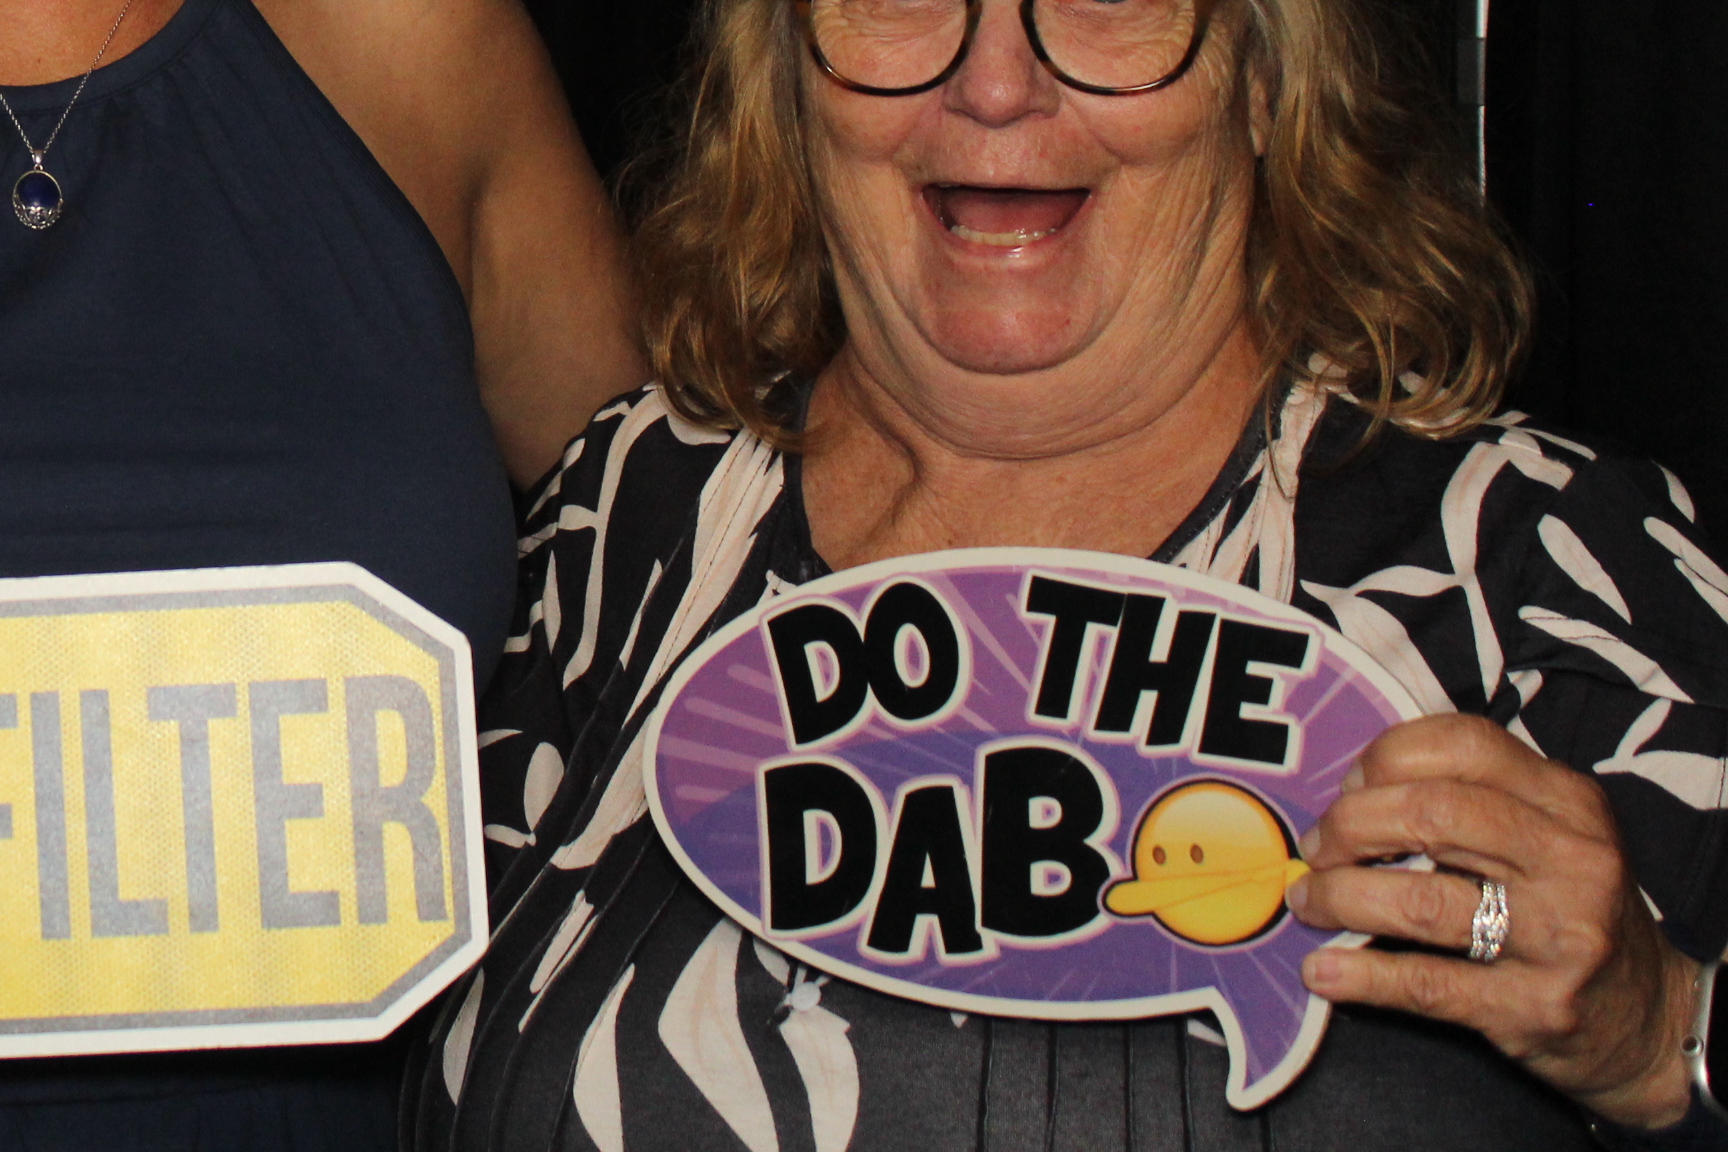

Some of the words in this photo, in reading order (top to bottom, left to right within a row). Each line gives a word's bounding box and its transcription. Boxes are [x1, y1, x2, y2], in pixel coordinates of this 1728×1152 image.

[766, 580, 960, 745] DO
[1025, 575, 1310, 766] THE
[763, 746, 1111, 954] DAB
